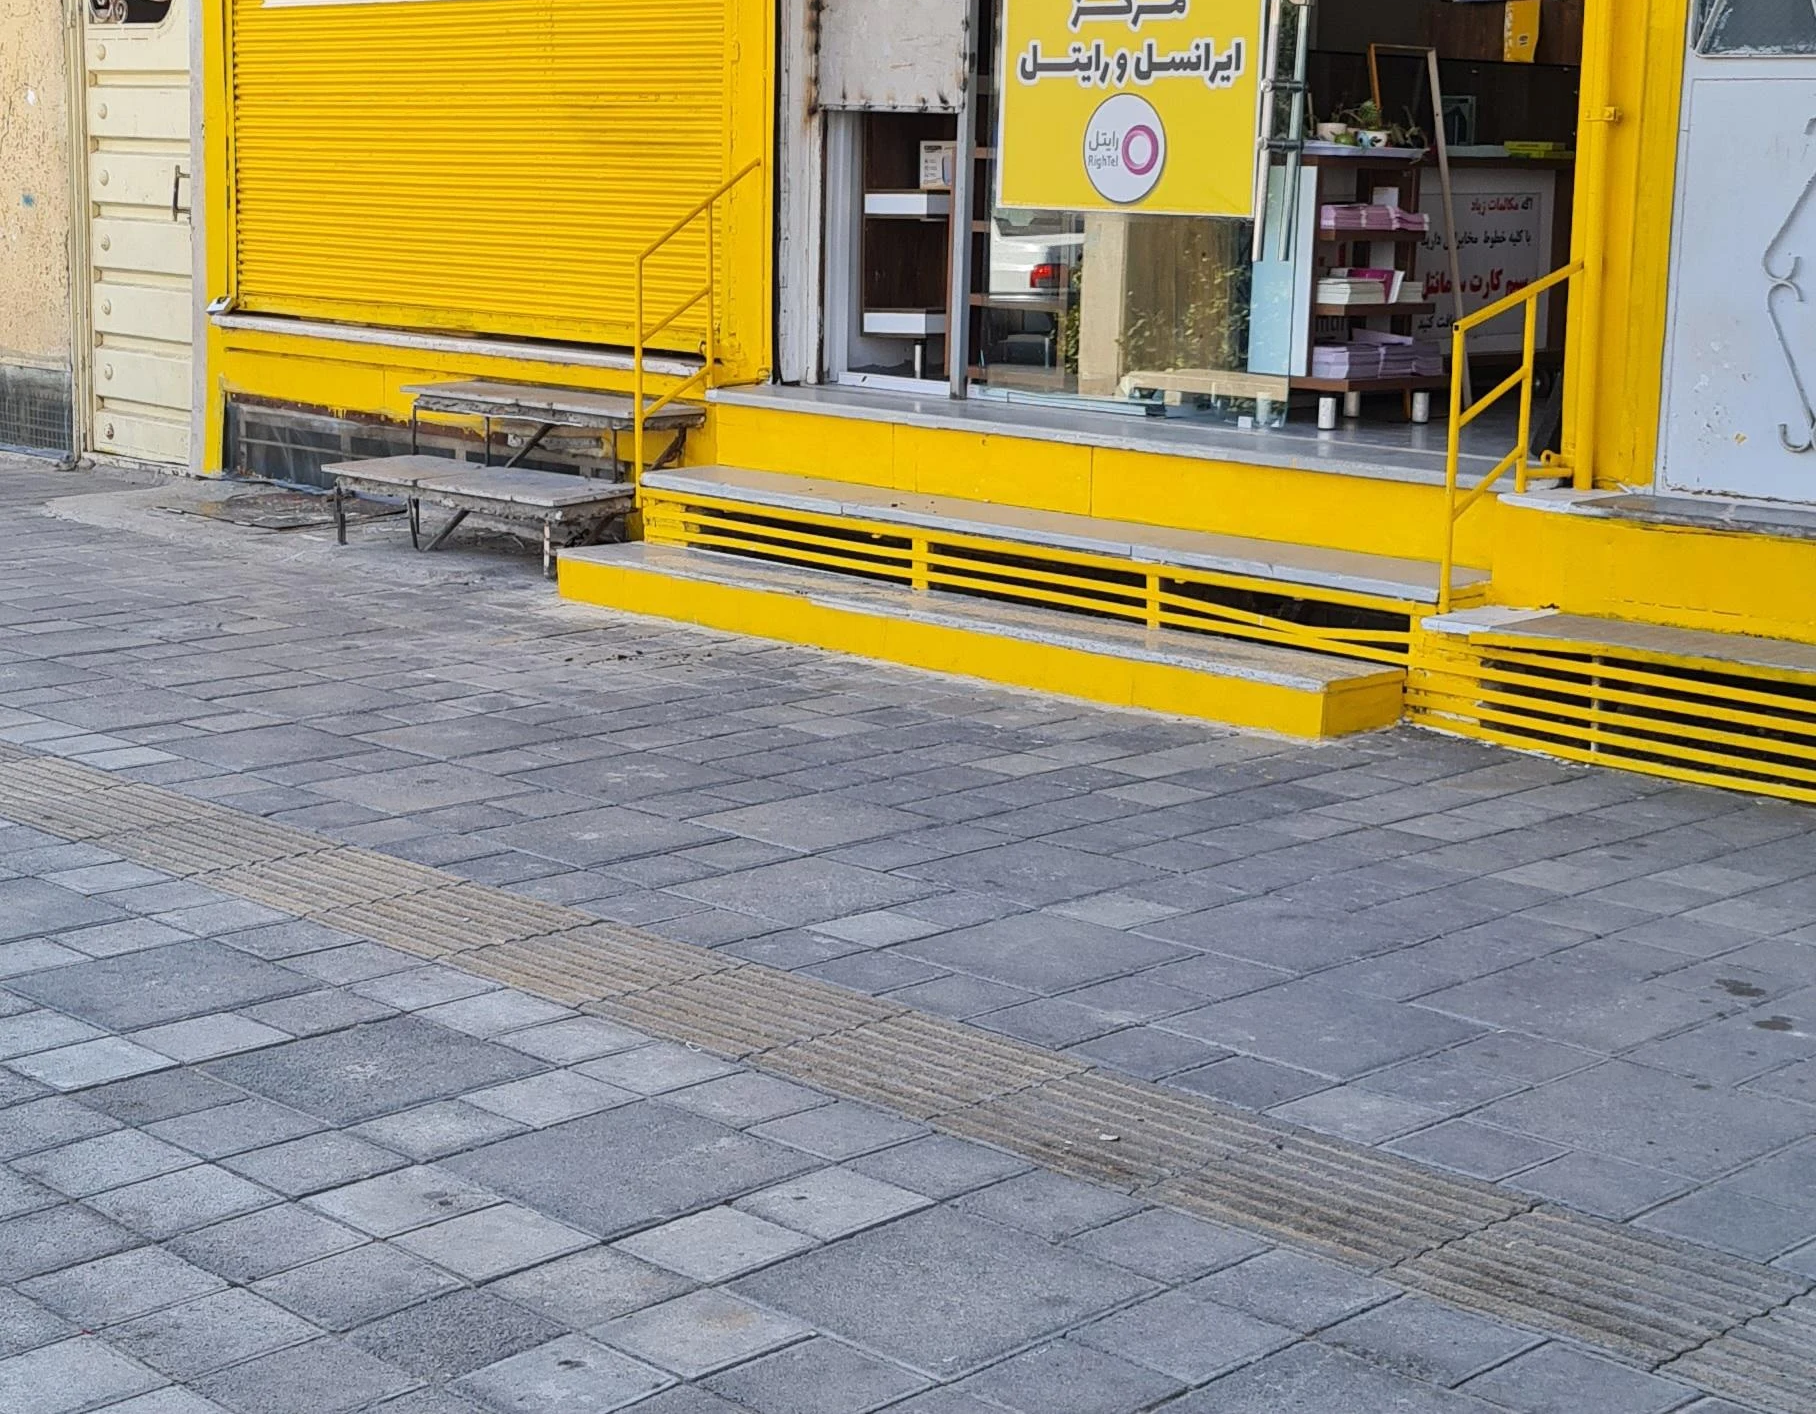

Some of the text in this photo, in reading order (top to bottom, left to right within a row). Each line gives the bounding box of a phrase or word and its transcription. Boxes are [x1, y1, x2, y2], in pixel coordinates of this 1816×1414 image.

[1020, 41, 1242, 83] ایرانسل و رایتل
[1088, 131, 1119, 151] رایتل
[1088, 153, 1119, 169] RighTel
[1422, 271, 1466, 300] مانتل
[1470, 268, 1504, 299] کارت
